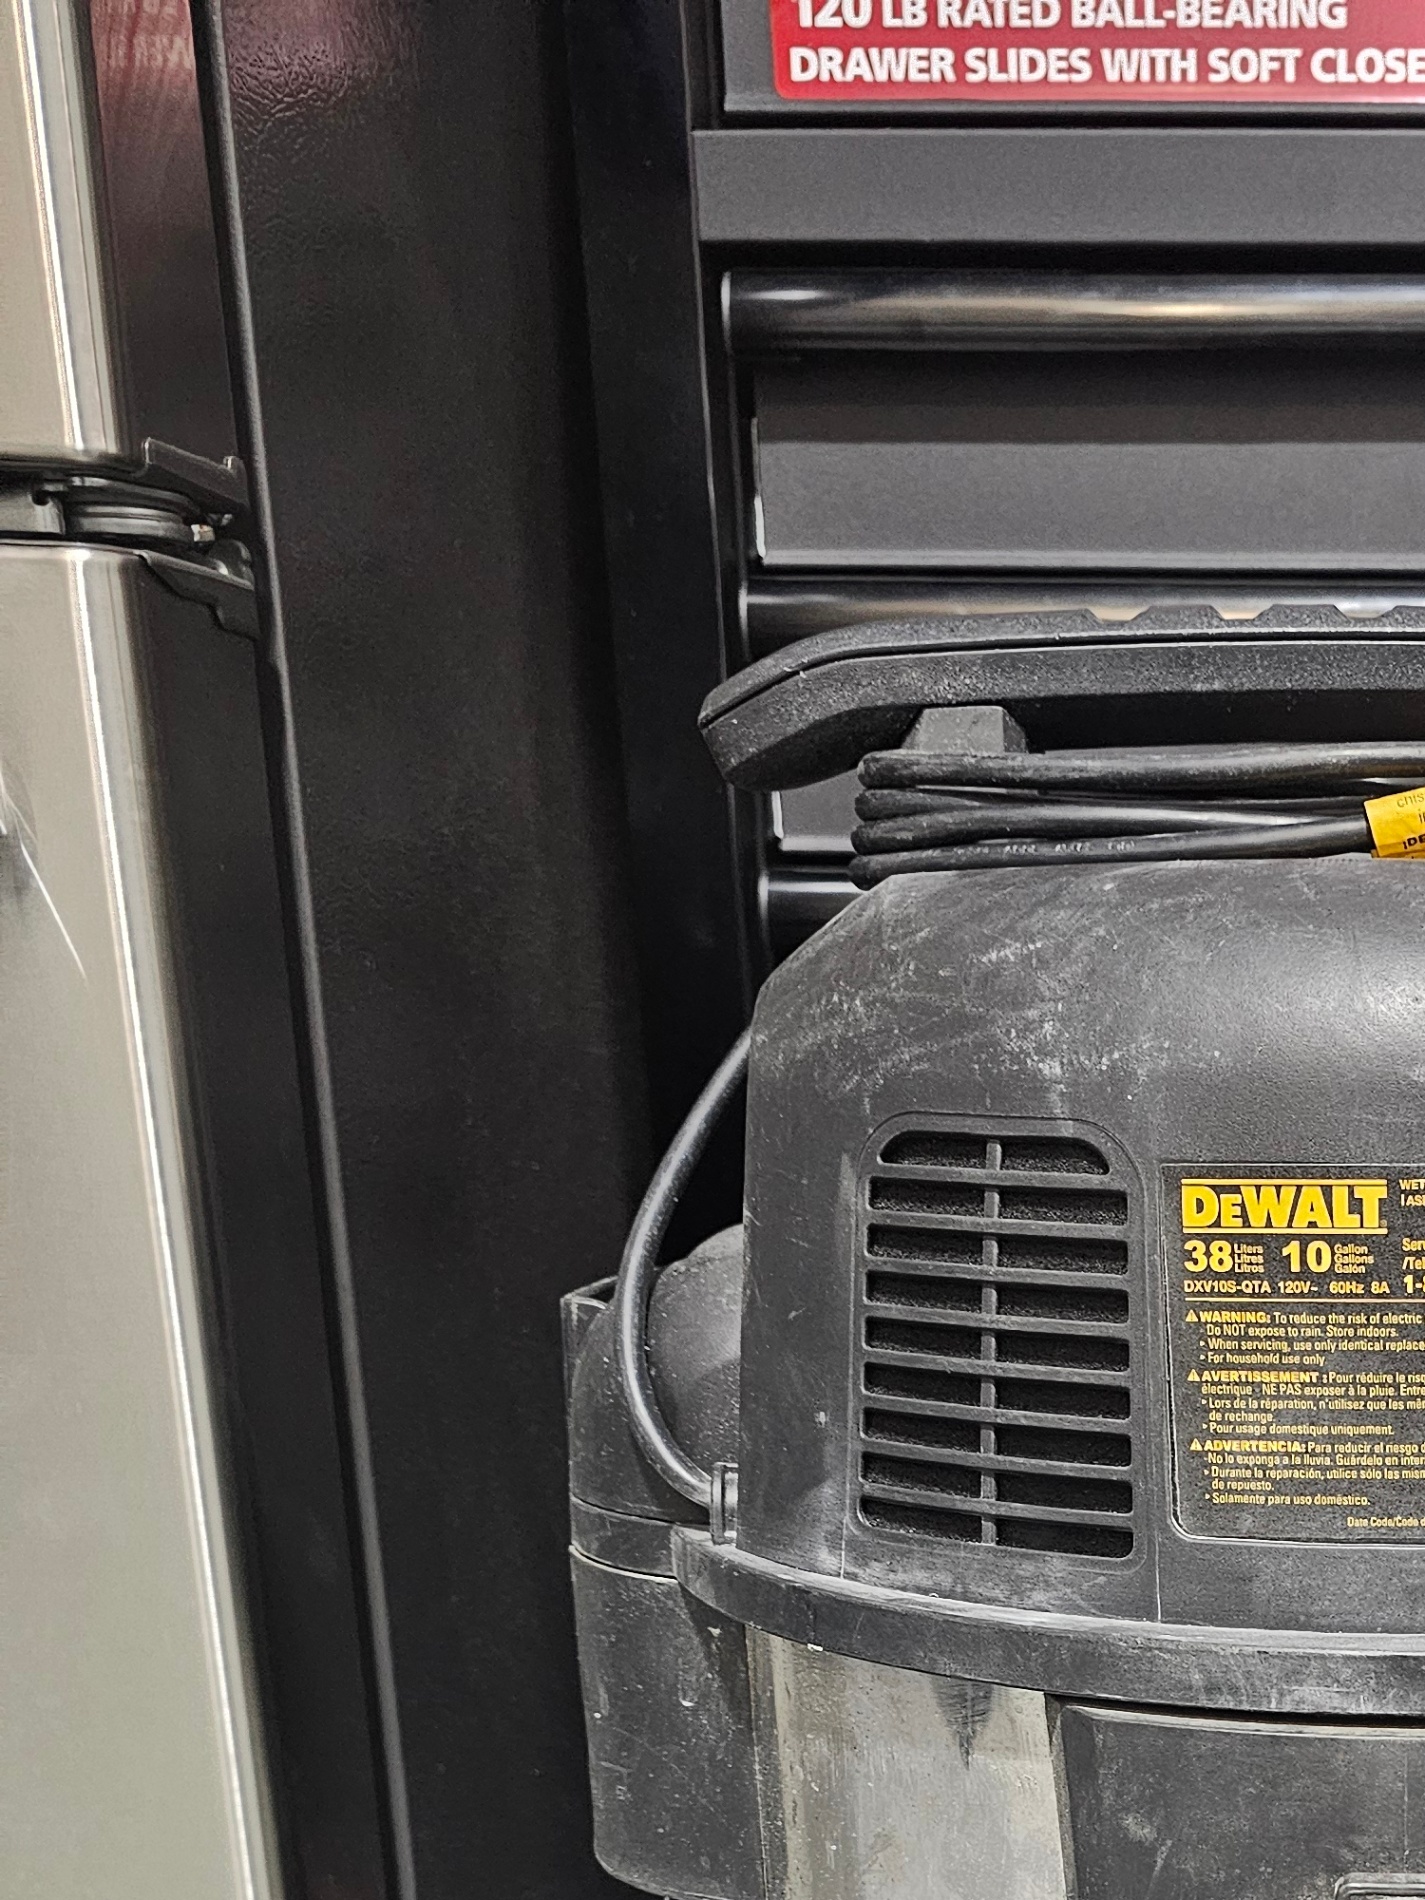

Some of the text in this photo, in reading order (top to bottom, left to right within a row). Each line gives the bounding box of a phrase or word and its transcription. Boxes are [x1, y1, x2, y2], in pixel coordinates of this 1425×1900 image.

[797, 0, 1347, 29] 120 LB RATED BALL-BEARING
[790, 46, 957, 83] DRAWER
[964, 46, 1093, 83] SLIDES
[1100, 47, 1199, 83] WITH
[1208, 47, 1303, 83] SOFT
[1234, 1243, 1368, 1254] Liters Gallon
[1184, 1239, 1332, 1273] 38 10
[1234, 1254, 1375, 1264] Litres Gallons
[1234, 1263, 1366, 1274] Litros Galón
[1184, 1280, 1272, 1294] DXV10S-QTA
[1329, 1281, 1365, 1294] 60Hz
[1371, 1281, 1390, 1294] 8A
[1200, 1310, 1271, 1324] WARNING:
[1273, 1312, 1287, 1324] To
[1289, 1312, 1325, 1324] reduce
[1328, 1313, 1345, 1324] the
[1348, 1313, 1368, 1324] risk
[1369, 1313, 1380, 1324] of
[1382, 1312, 1422, 1324] electric
[1206, 1324, 1399, 1338] Do NOT expose to rain. Store indoors.
[1207, 1338, 1239, 1350] When
[1240, 1338, 1292, 1353] servicing,
[1293, 1341, 1312, 1351] use
[1314, 1339, 1336, 1353] only
[1338, 1339, 1384, 1351] identical
[1207, 1352, 1300, 1364] For household use
[1202, 1370, 1320, 1383] AVERTISSEMENT
[1356, 1372, 1394, 1383] réduire
[1396, 1372, 1405, 1383] le
[1262, 1384, 1277, 1395] NE
[1279, 1384, 1301, 1396] PAS
[1304, 1386, 1345, 1397] exposer
[1357, 1385, 1367, 1396] la
[1209, 1397, 1231, 1409] Lors
[1233, 1398, 1246, 1408] de
[1249, 1398, 1258, 1408] la
[1366, 1401, 1387, 1412] que
[1388, 1399, 1404, 1410] les
[1209, 1411, 1276, 1424] de rechange.
[1209, 1423, 1395, 1437] Pour usage domestique uniquement.
[1204, 1439, 1306, 1452] ADVERTENCIA:
[1307, 1442, 1332, 1453] Para
[1334, 1442, 1372, 1454] reducir
[1374, 1442, 1383, 1454] el
[1385, 1442, 1418, 1455] riesgo
[1225, 1453, 1235, 1464] lo
[1236, 1455, 1280, 1467] exponga
[1291, 1454, 1301, 1465] la
[1303, 1454, 1333, 1465] lluvia.
[1335, 1454, 1383, 1466] Guárdelo
[1385, 1456, 1398, 1466] en
[1210, 1466, 1251, 1478] Durante
[1253, 1467, 1263, 1478] la
[1326, 1468, 1358, 1479] utilice
[1360, 1467, 1382, 1479] sólo
[1384, 1468, 1400, 1479] las
[1211, 1480, 1275, 1492] de repuesto.
[1212, 1493, 1371, 1506] Solamente para uso doméstico.
[1347, 1516, 1368, 1527] Date
[1370, 1516, 1419, 1527] Code/Code
